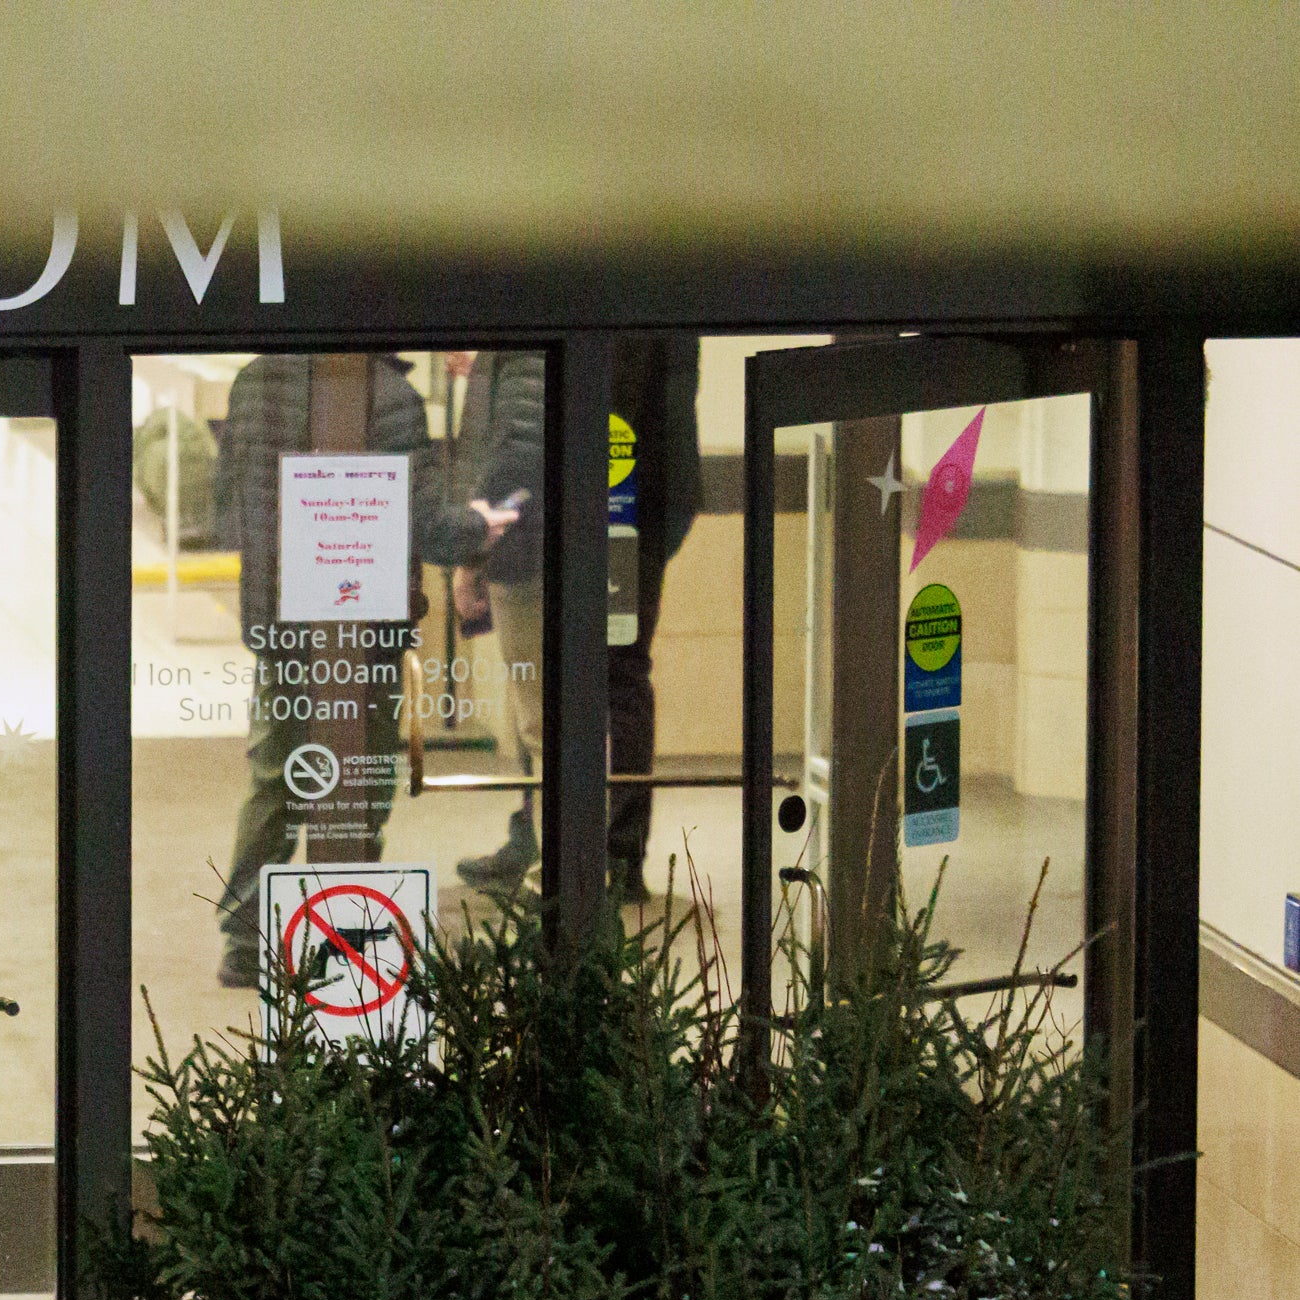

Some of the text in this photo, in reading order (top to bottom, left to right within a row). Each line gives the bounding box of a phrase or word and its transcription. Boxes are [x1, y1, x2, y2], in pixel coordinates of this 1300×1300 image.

[314, 512, 379, 523] 10am-9pm
[318, 541, 373, 551] Saturday
[250, 624, 423, 649] Store Hours
[908, 619, 958, 639] CAUTION
[222, 660, 269, 686] Sat
[275, 659, 398, 685] 10:00am
[180, 697, 232, 721] Sun
[243, 694, 358, 721] 11:00am
[362, 767, 392, 775] smoke
[285, 801, 314, 811] Thank
[318, 803, 335, 812] you
[337, 801, 351, 810] for
[353, 801, 369, 810] not
